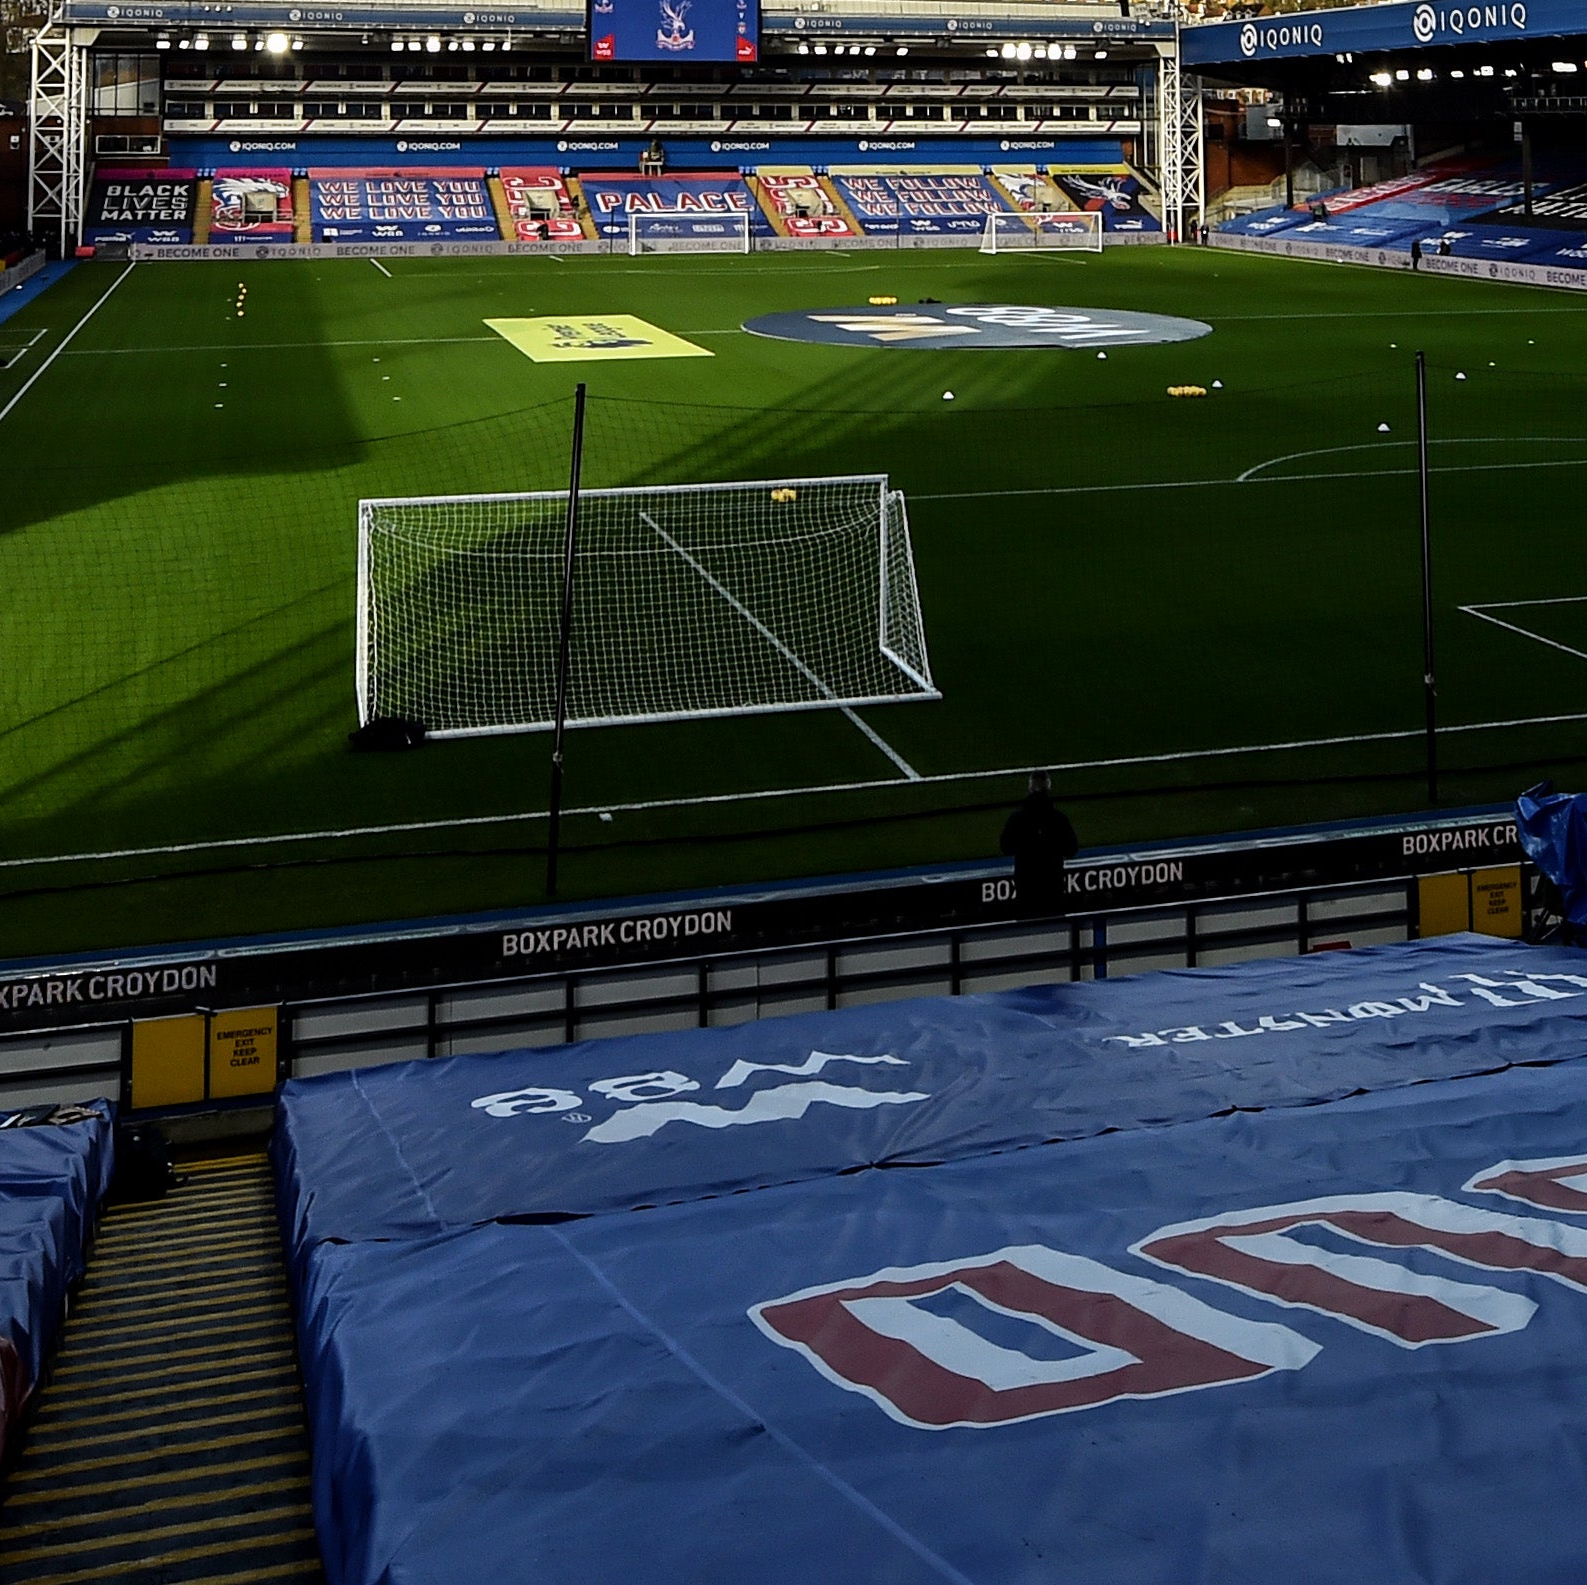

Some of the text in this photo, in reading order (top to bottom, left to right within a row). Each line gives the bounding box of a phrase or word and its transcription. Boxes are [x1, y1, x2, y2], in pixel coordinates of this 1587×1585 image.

[121, 8, 163, 17] IQONIQ
[303, 12, 343, 20] IQONIQ
[476, 14, 515, 23] IQONIQ
[1440, 2, 1527, 34] IQONIQ
[806, 20, 842, 28] IQONIQ
[957, 21, 993, 29] IQONIQ
[1106, 22, 1137, 31] IQONIQ
[1260, 23, 1322, 49] IQONIQ
[318, 181, 481, 194] WE LOVE YOU
[840, 177, 983, 190] WE FOLLOW
[107, 185, 189, 196] BLACK
[848, 190, 993, 202] WE FOLLOW
[103, 197, 188, 210] LIVES
[319, 193, 484, 206] WE LOVE YOU
[595, 192, 755, 214] PALACE
[320, 206, 487, 219] WE LOVE YOU
[858, 202, 1003, 215] WE FOLLOW
[100, 210, 187, 221] MATTER
[157, 247, 240, 258] BECOME ONE
[337, 245, 415, 256] BECOME ONE
[507, 243, 583, 254] BECOME ONE
[1425, 258, 1459, 272] BECOME
[1460, 262, 1479, 274] ONE
[1546, 271, 1587, 287] BECOME
[945, 305, 1151, 341] W88
[1402, 824, 1491, 856] BOXPARK
[1083, 861, 1184, 892] CROYDON
[501, 910, 734, 957] BOXPARK CROYDON
[88, 965, 218, 1000] CROYDON
[1099, 978, 1468, 1050] MONSTER
[217, 1027, 273, 1040] EMERGENCY
[235, 1038, 255, 1048] EXIT
[233, 1047, 257, 1057] KEEP
[230, 1057, 260, 1067] CLEAR
[470, 1049, 911, 1120] W88
